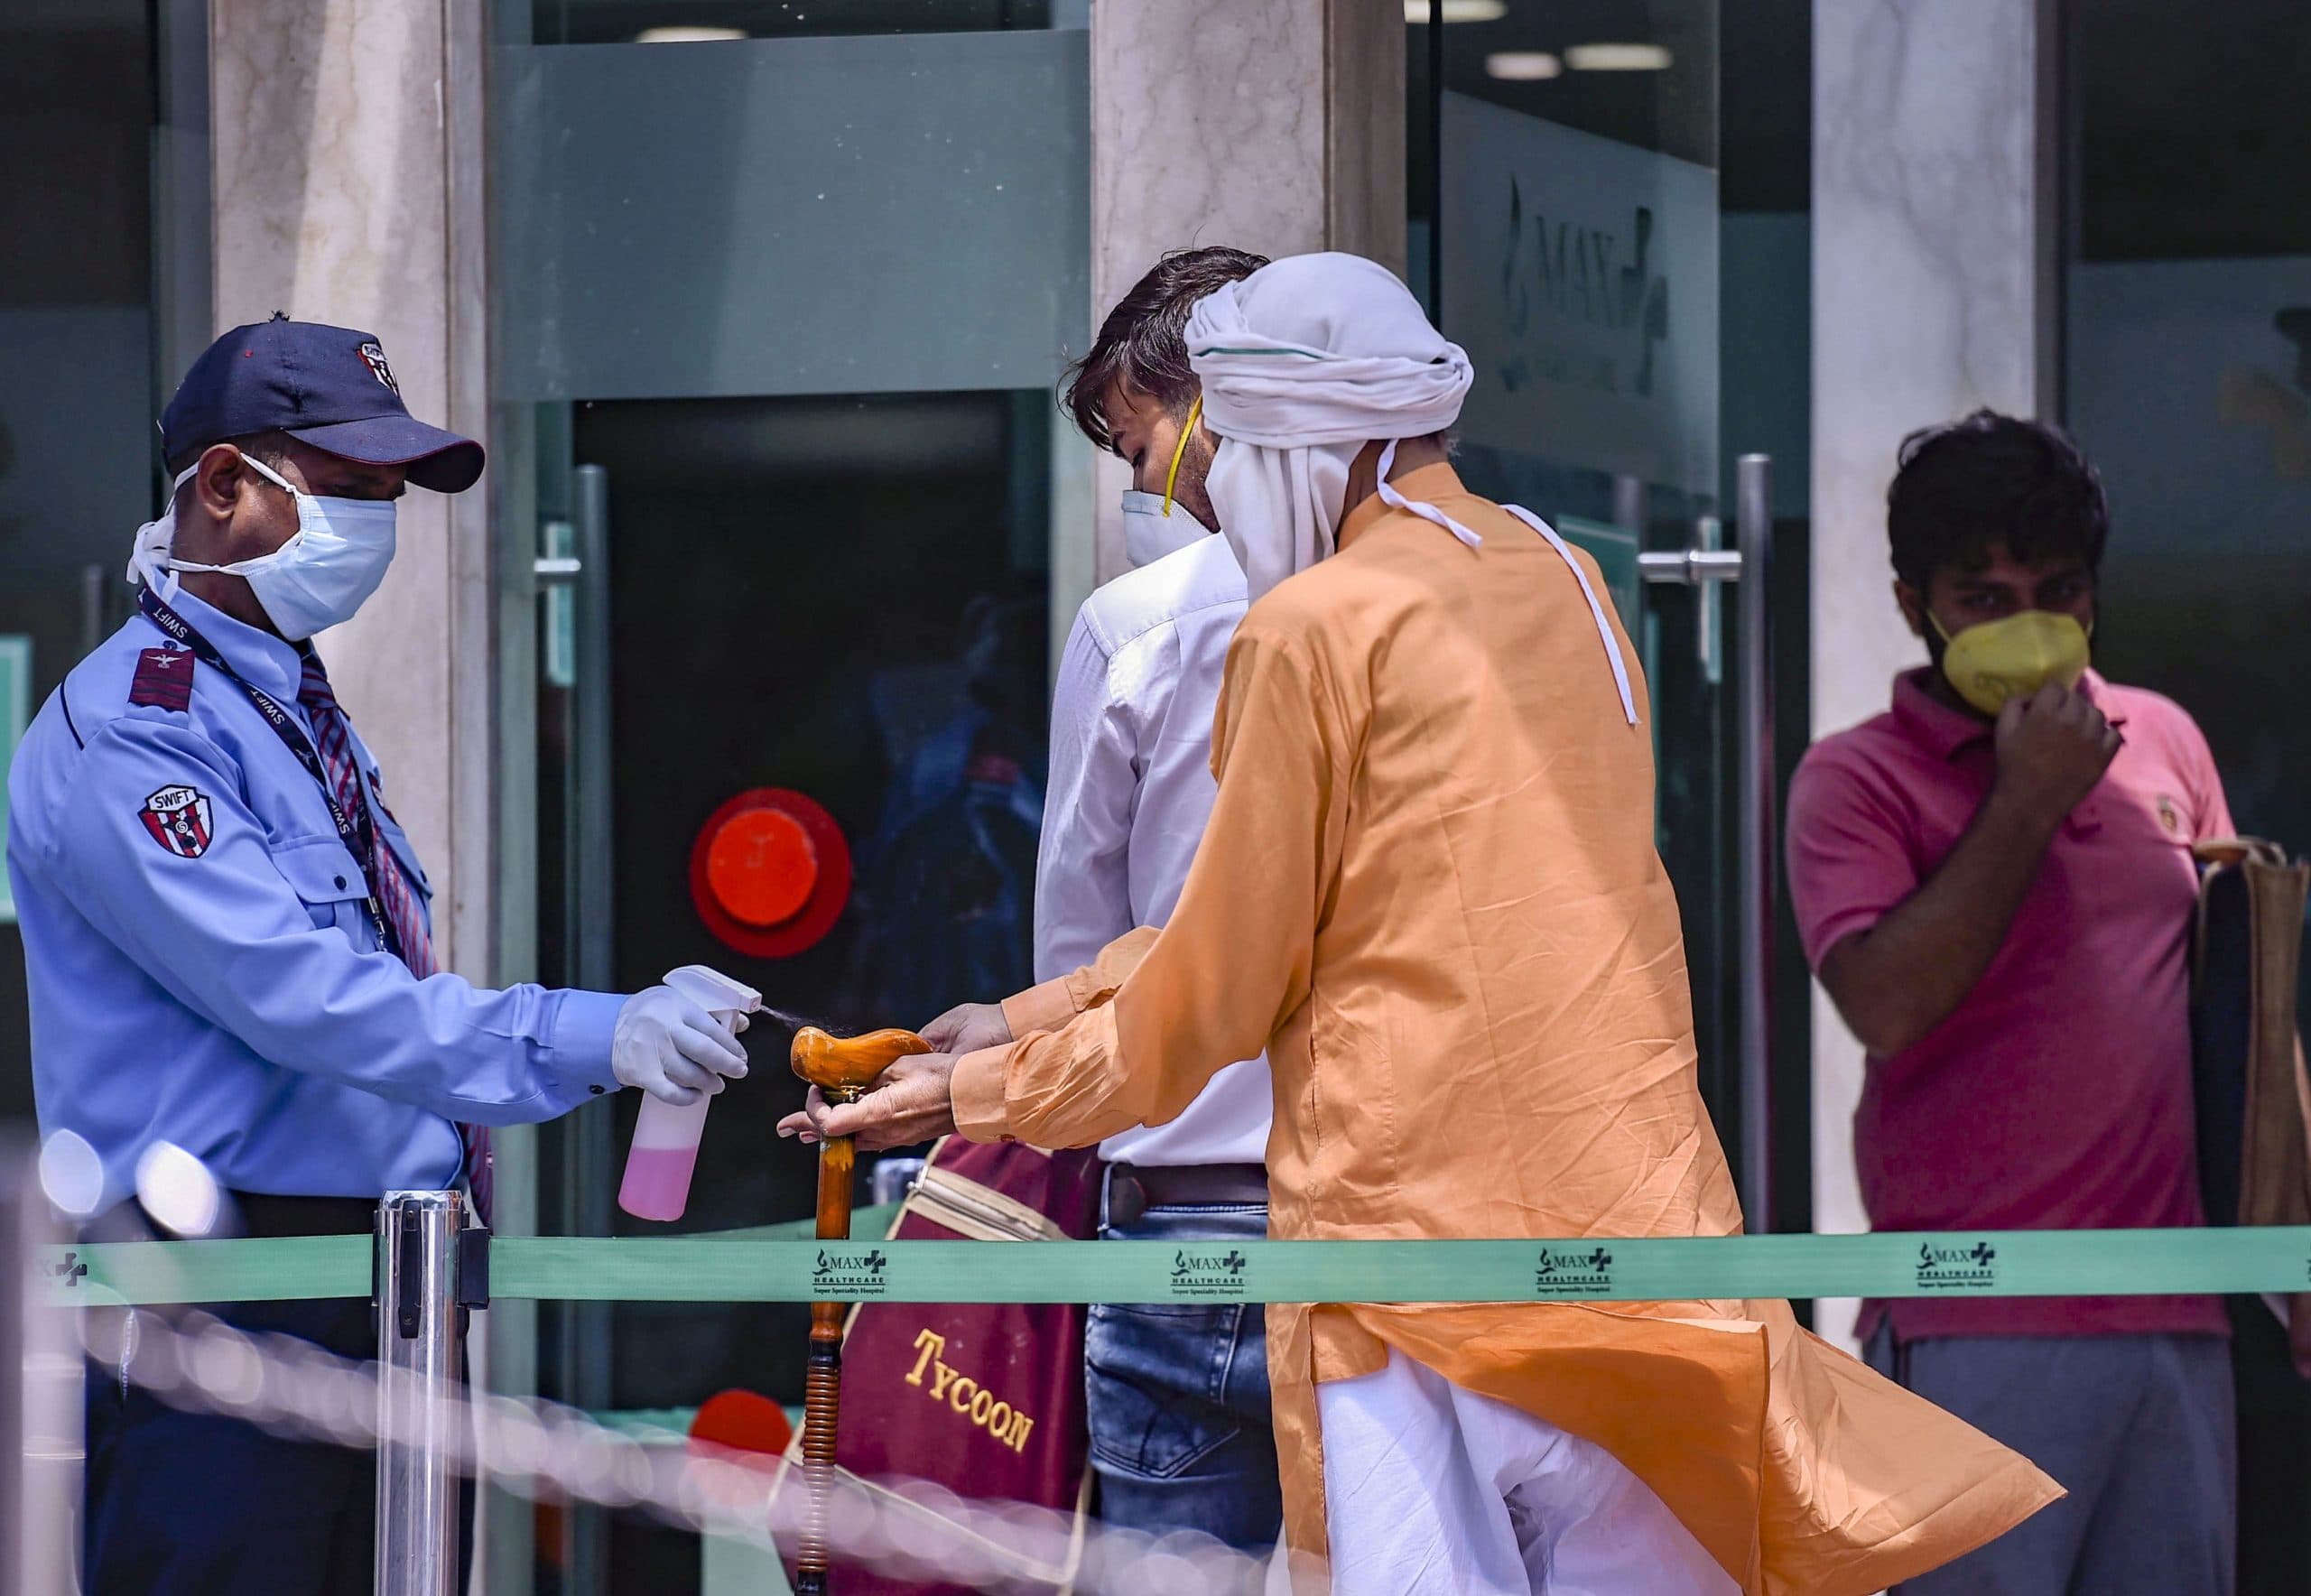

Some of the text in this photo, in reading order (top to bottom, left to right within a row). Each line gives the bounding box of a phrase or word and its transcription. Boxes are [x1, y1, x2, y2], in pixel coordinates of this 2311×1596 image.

[153, 607, 188, 639] SWIFT
[250, 690, 285, 725] SWIFT
[154, 790, 189, 809] SWIFT
[330, 803, 350, 835] SWIF
[830, 1257, 863, 1270] MAX
[1188, 1257, 1222, 1271] MAX
[1553, 1256, 1588, 1269] MAX
[1935, 1249, 1970, 1263] MAX
